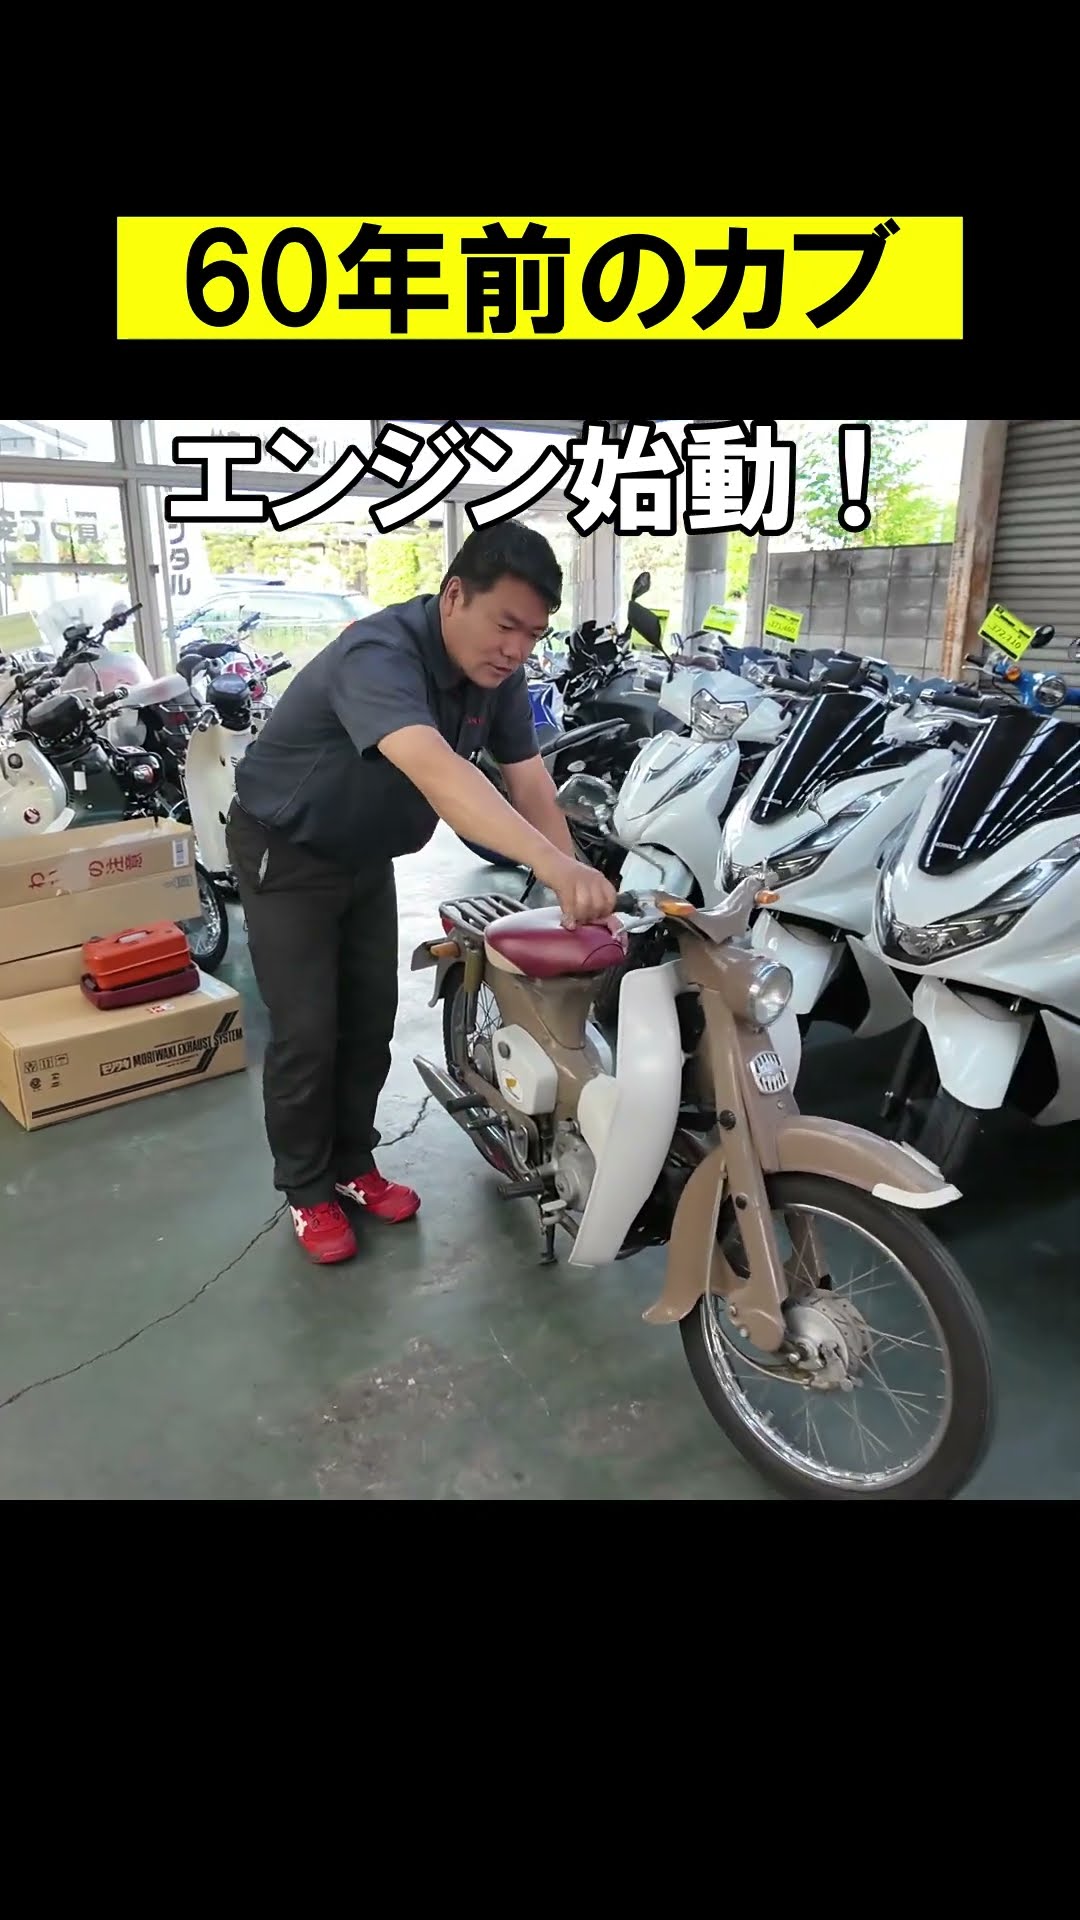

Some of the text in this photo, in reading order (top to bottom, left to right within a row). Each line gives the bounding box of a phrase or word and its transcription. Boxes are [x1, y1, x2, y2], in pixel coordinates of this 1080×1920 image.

[133, 1045, 177, 1067] MORIWAKI
[178, 1037, 212, 1056] EXHAUST
[213, 1027, 243, 1047] SYSTEM
